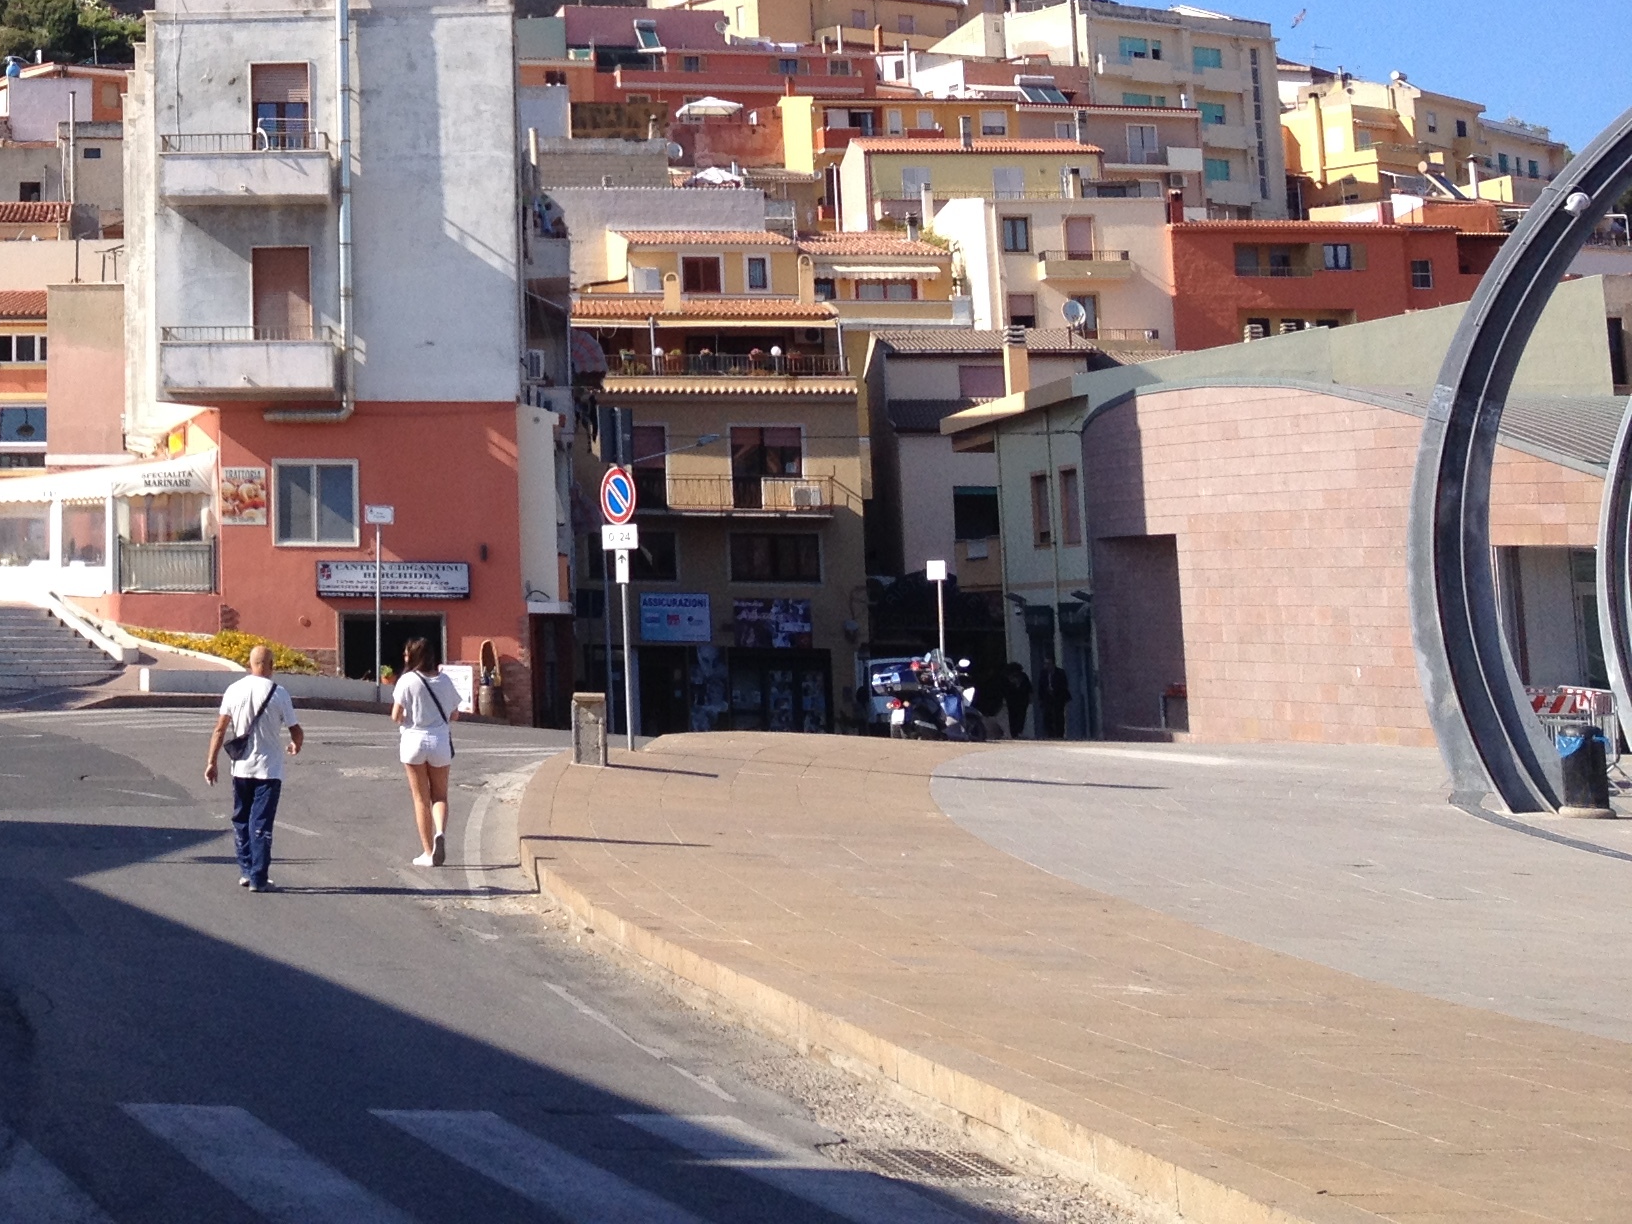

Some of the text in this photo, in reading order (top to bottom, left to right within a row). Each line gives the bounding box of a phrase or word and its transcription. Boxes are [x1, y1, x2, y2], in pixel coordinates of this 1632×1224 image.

[144, 479, 191, 487] MARINARE
[608, 532, 631, 541] 0 24
[642, 597, 707, 607] ASSICURAZIONI
